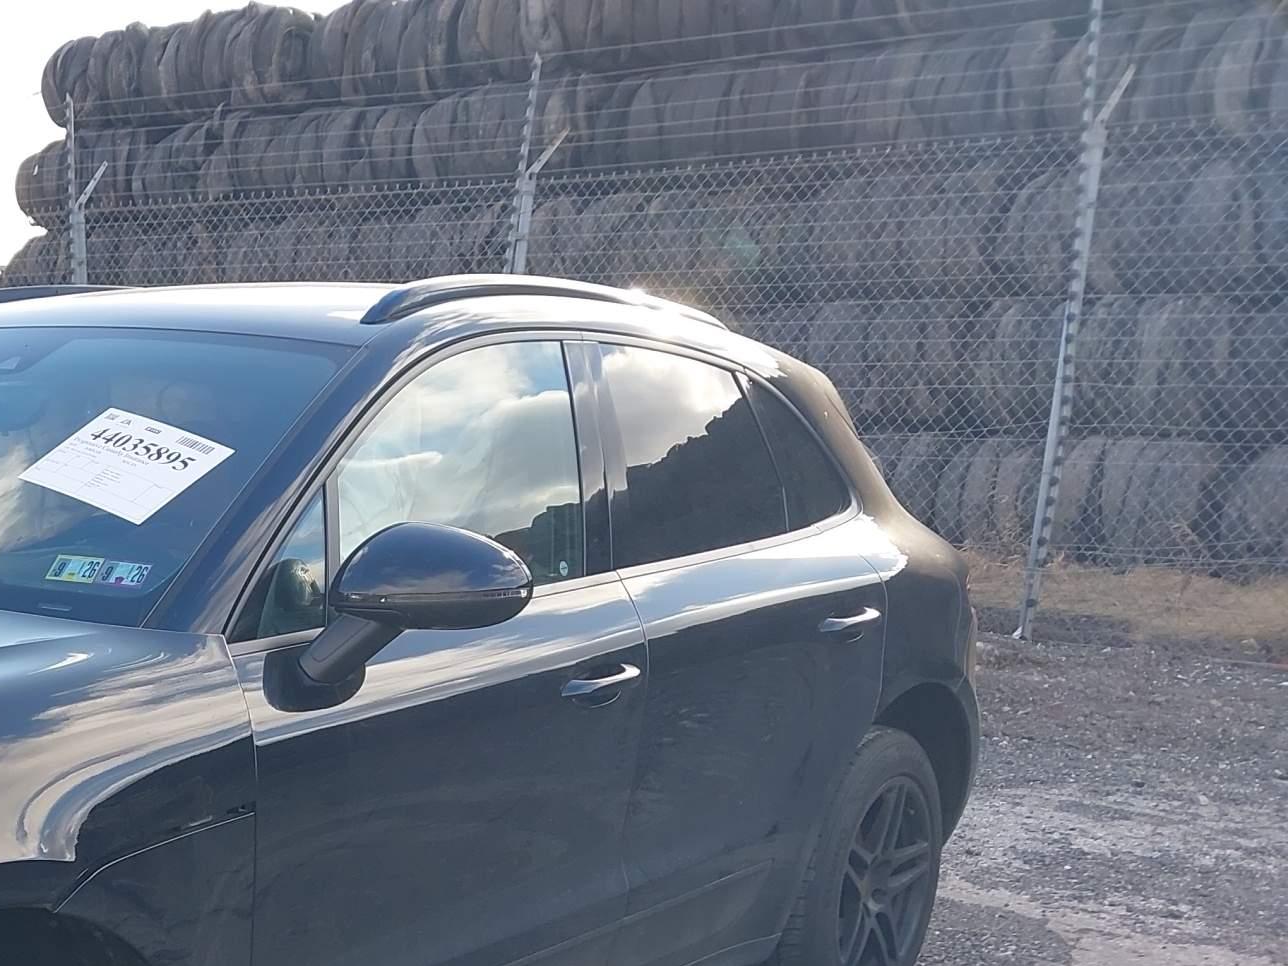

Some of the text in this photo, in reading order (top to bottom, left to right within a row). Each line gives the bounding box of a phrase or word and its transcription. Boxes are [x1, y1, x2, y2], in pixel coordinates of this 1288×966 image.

[90, 427, 197, 471] 44035895
[54, 562, 66, 577] 9
[102, 566, 114, 581] 9
